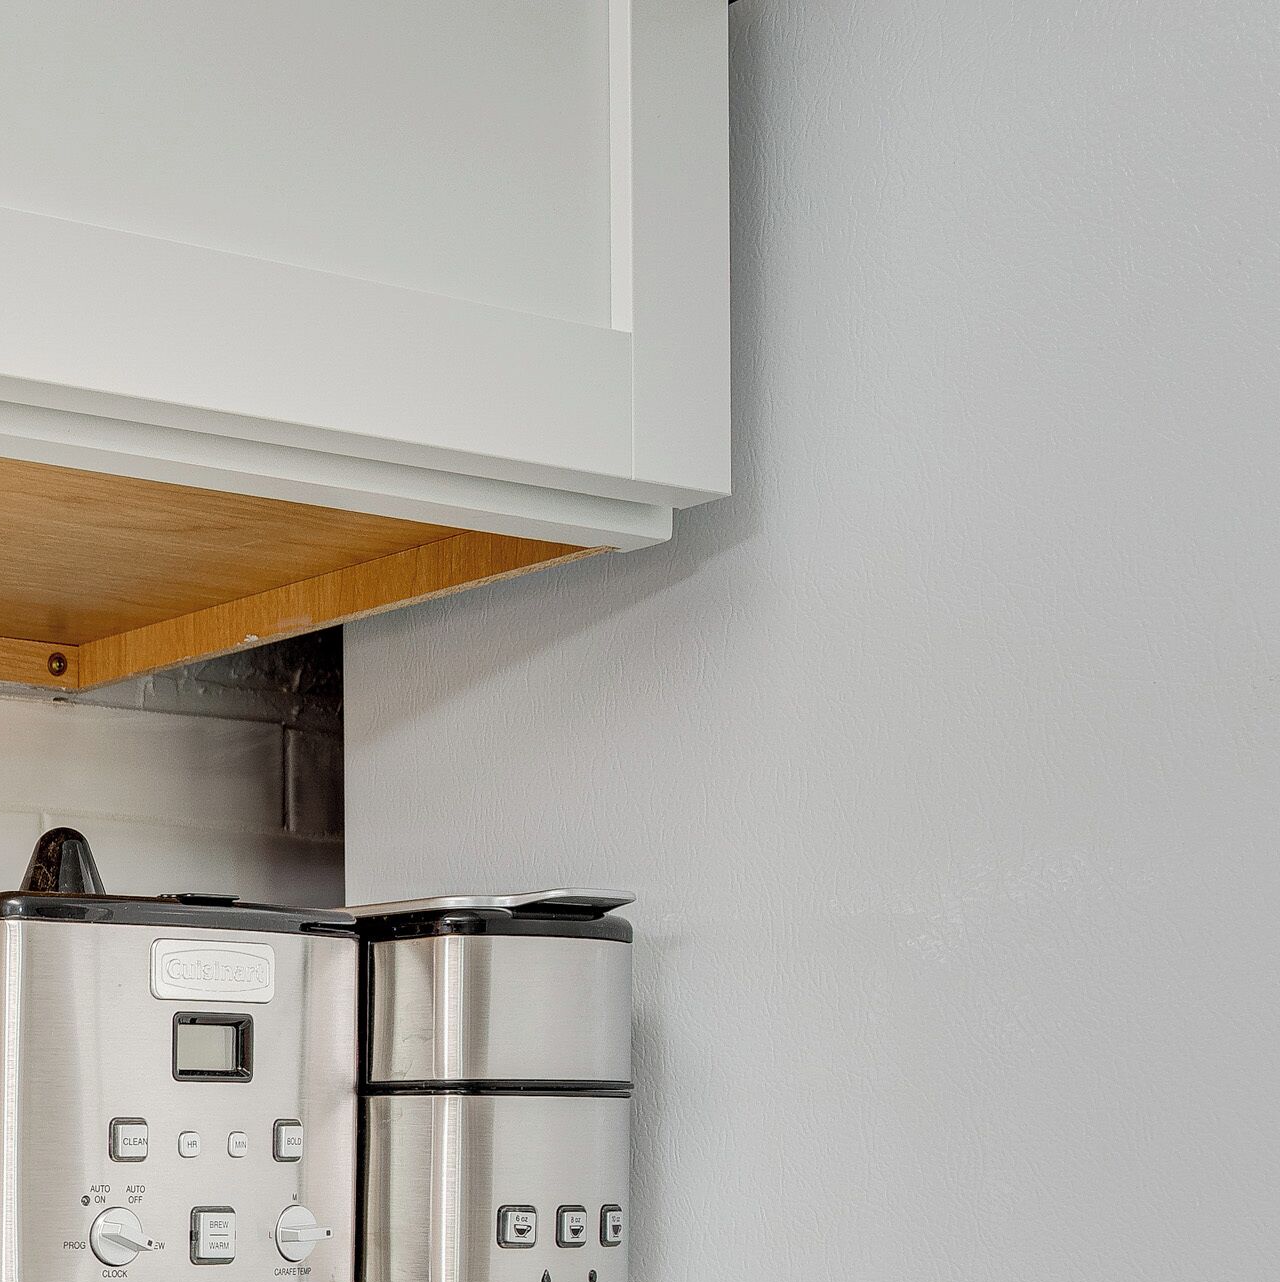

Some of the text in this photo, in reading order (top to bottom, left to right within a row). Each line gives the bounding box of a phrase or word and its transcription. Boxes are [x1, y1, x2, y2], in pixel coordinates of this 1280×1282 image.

[167, 958, 264, 983] Cuisinart
[123, 1137, 148, 1146] CLEAN
[187, 1140, 198, 1148] HR
[287, 1137, 301, 1145] BOLD
[90, 1185, 110, 1193] AUTO
[126, 1185, 146, 1193] AUTO
[94, 1195, 106, 1204] ON
[128, 1196, 143, 1204] OFF
[63, 1241, 86, 1250] PROG
[209, 1241, 229, 1249] WARM
[102, 1270, 127, 1278] CLOCK
[274, 1267, 311, 1276] CARAFE TEMP
